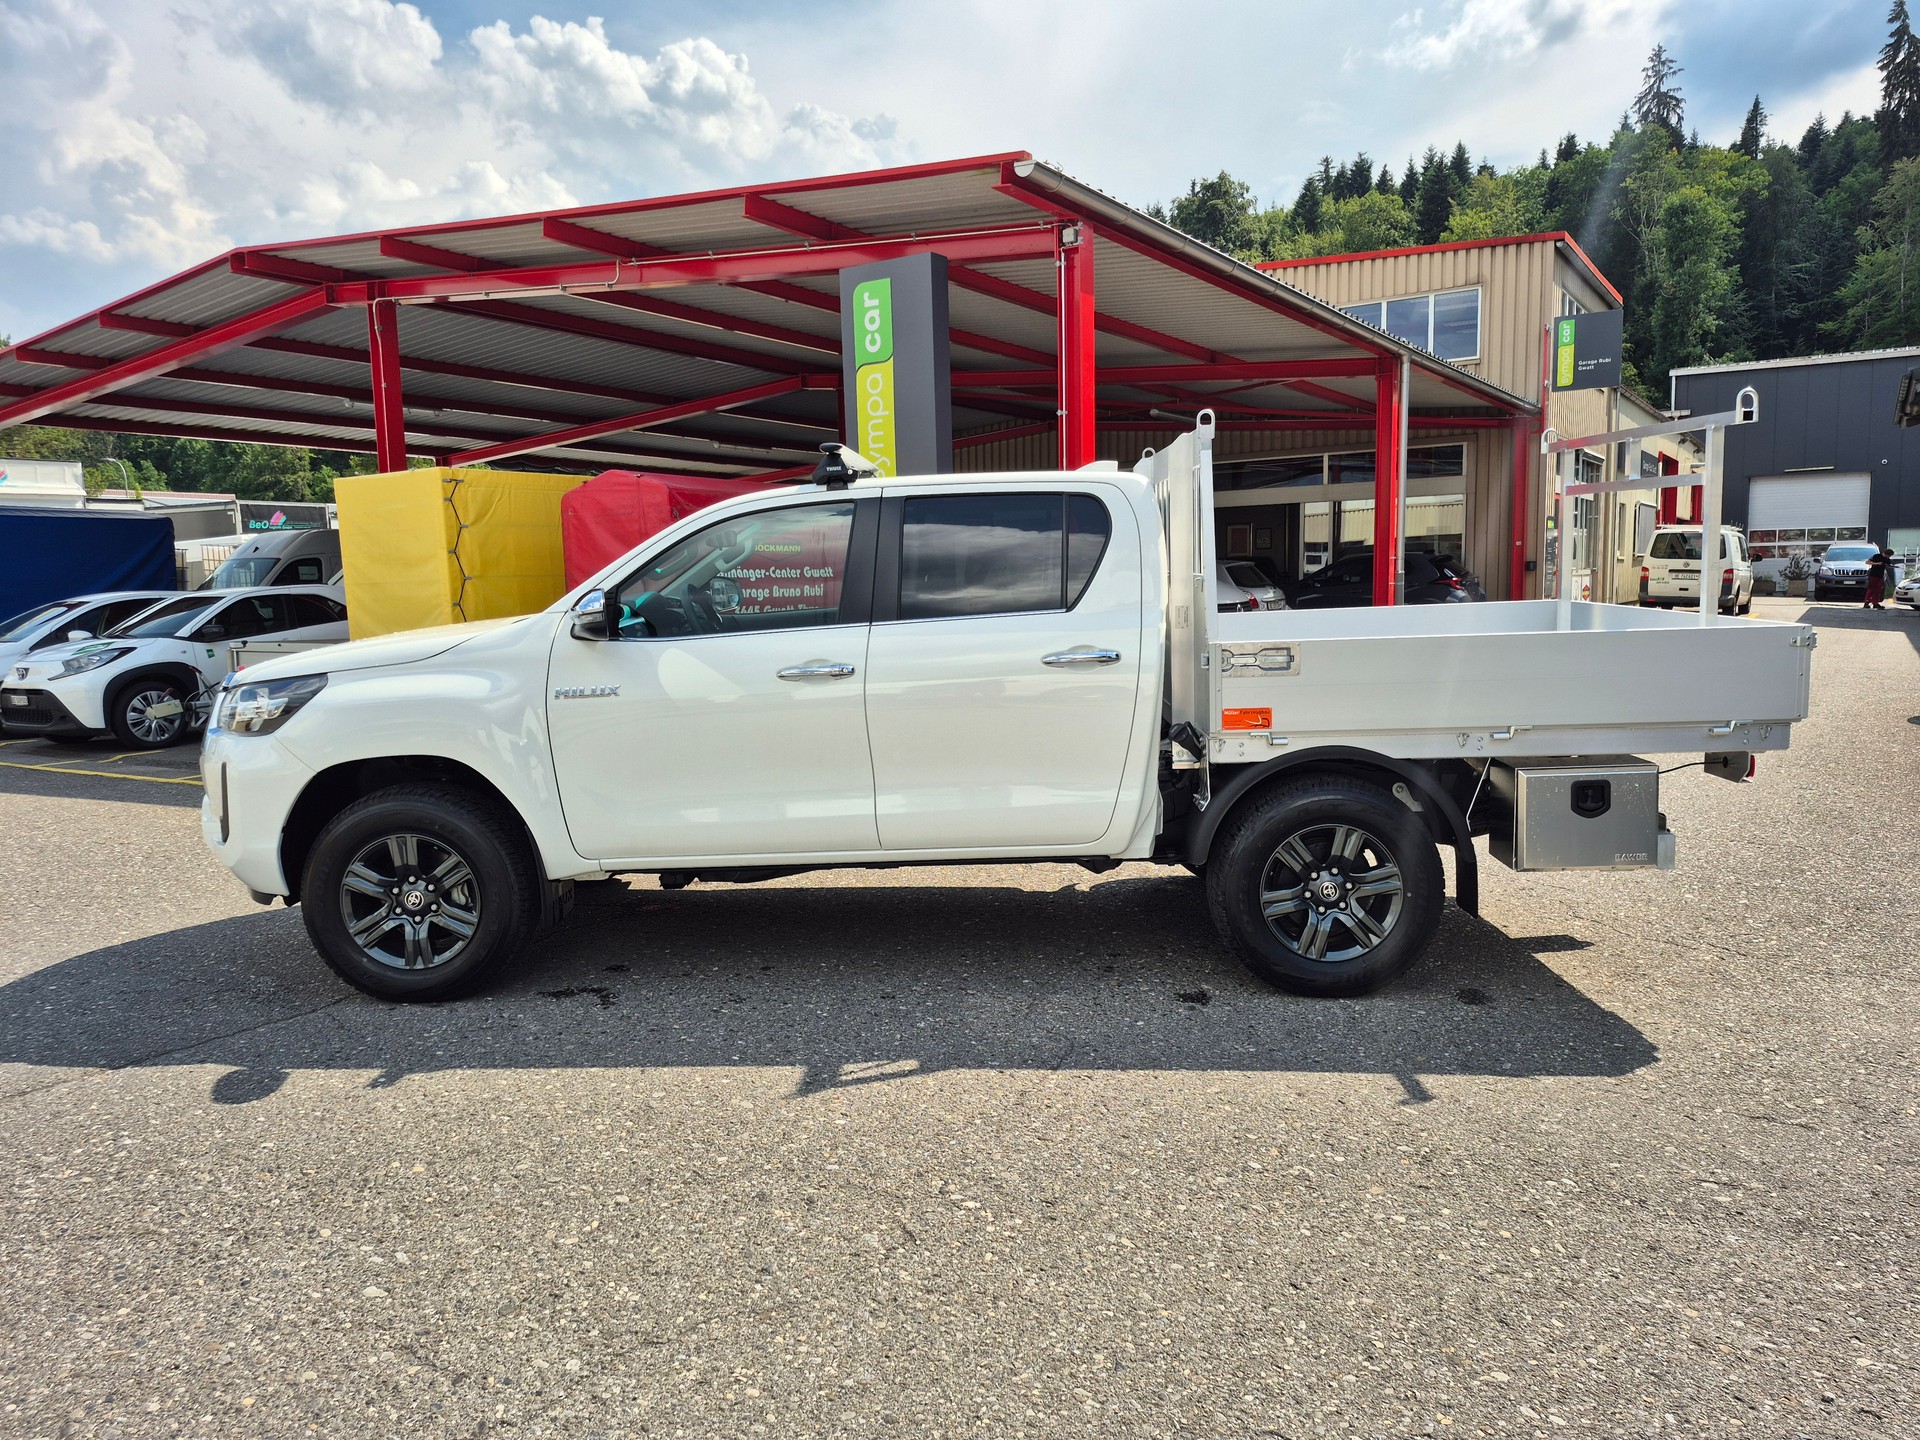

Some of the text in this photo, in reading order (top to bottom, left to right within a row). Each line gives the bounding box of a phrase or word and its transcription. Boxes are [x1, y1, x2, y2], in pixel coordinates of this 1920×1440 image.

[864, 292, 881, 353] car
[1562, 347, 1571, 384] sympa
[249, 520, 269, 529] BeO
[803, 566, 833, 578] Gwatt
[742, 583, 824, 601] rage Bruno Rubi
[555, 684, 621, 699] HILUX
